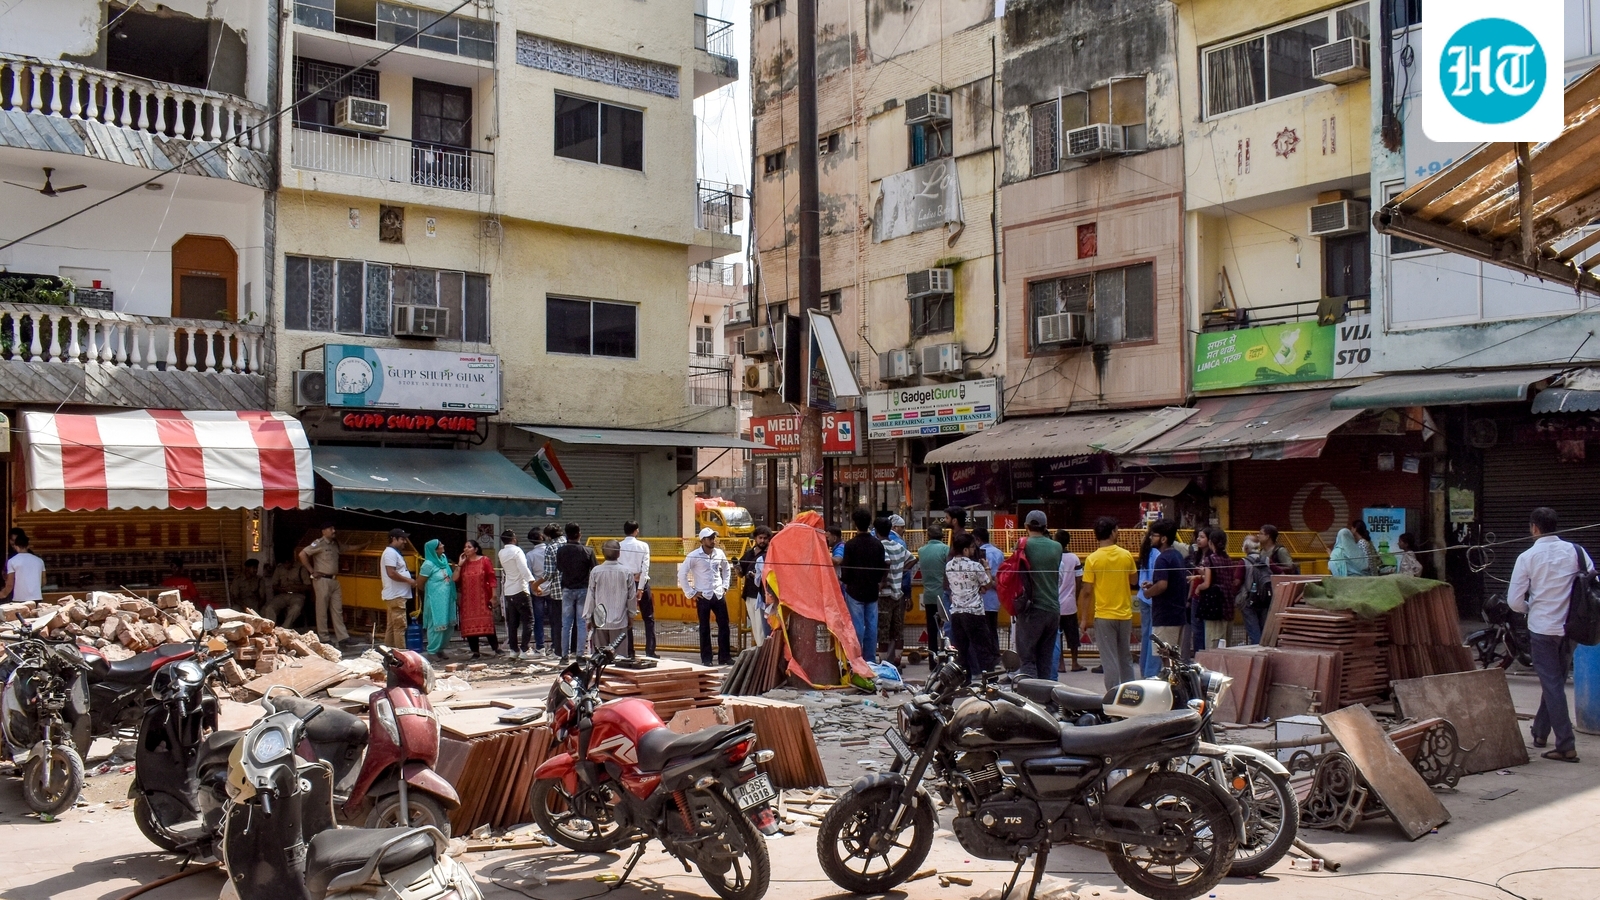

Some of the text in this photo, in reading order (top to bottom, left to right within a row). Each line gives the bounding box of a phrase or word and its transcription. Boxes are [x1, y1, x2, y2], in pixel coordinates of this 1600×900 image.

[1197, 359, 1220, 373] LIMCA
[388, 369, 485, 382] GUPP SHUPP GHAR
[901, 387, 958, 404] GadgetGuru
[343, 413, 476, 431] GUPP SHUPP GHAR
[894, 419, 925, 427] REPAIRING
[937, 414, 959, 422] MONEY
[960, 412, 992, 421] TRANSFER
[774, 432, 828, 446] PHARY
[1050, 456, 1089, 471] WALI FIZZ
[952, 465, 976, 481] CAMPA
[952, 485, 967, 496] WALI
[1368, 516, 1390, 524] DARR
[1370, 524, 1390, 532] JEET
[33, 523, 227, 548] SAHIL
[45, 552, 156, 567] ROPERTY
[1003, 816, 1022, 824] TVS
